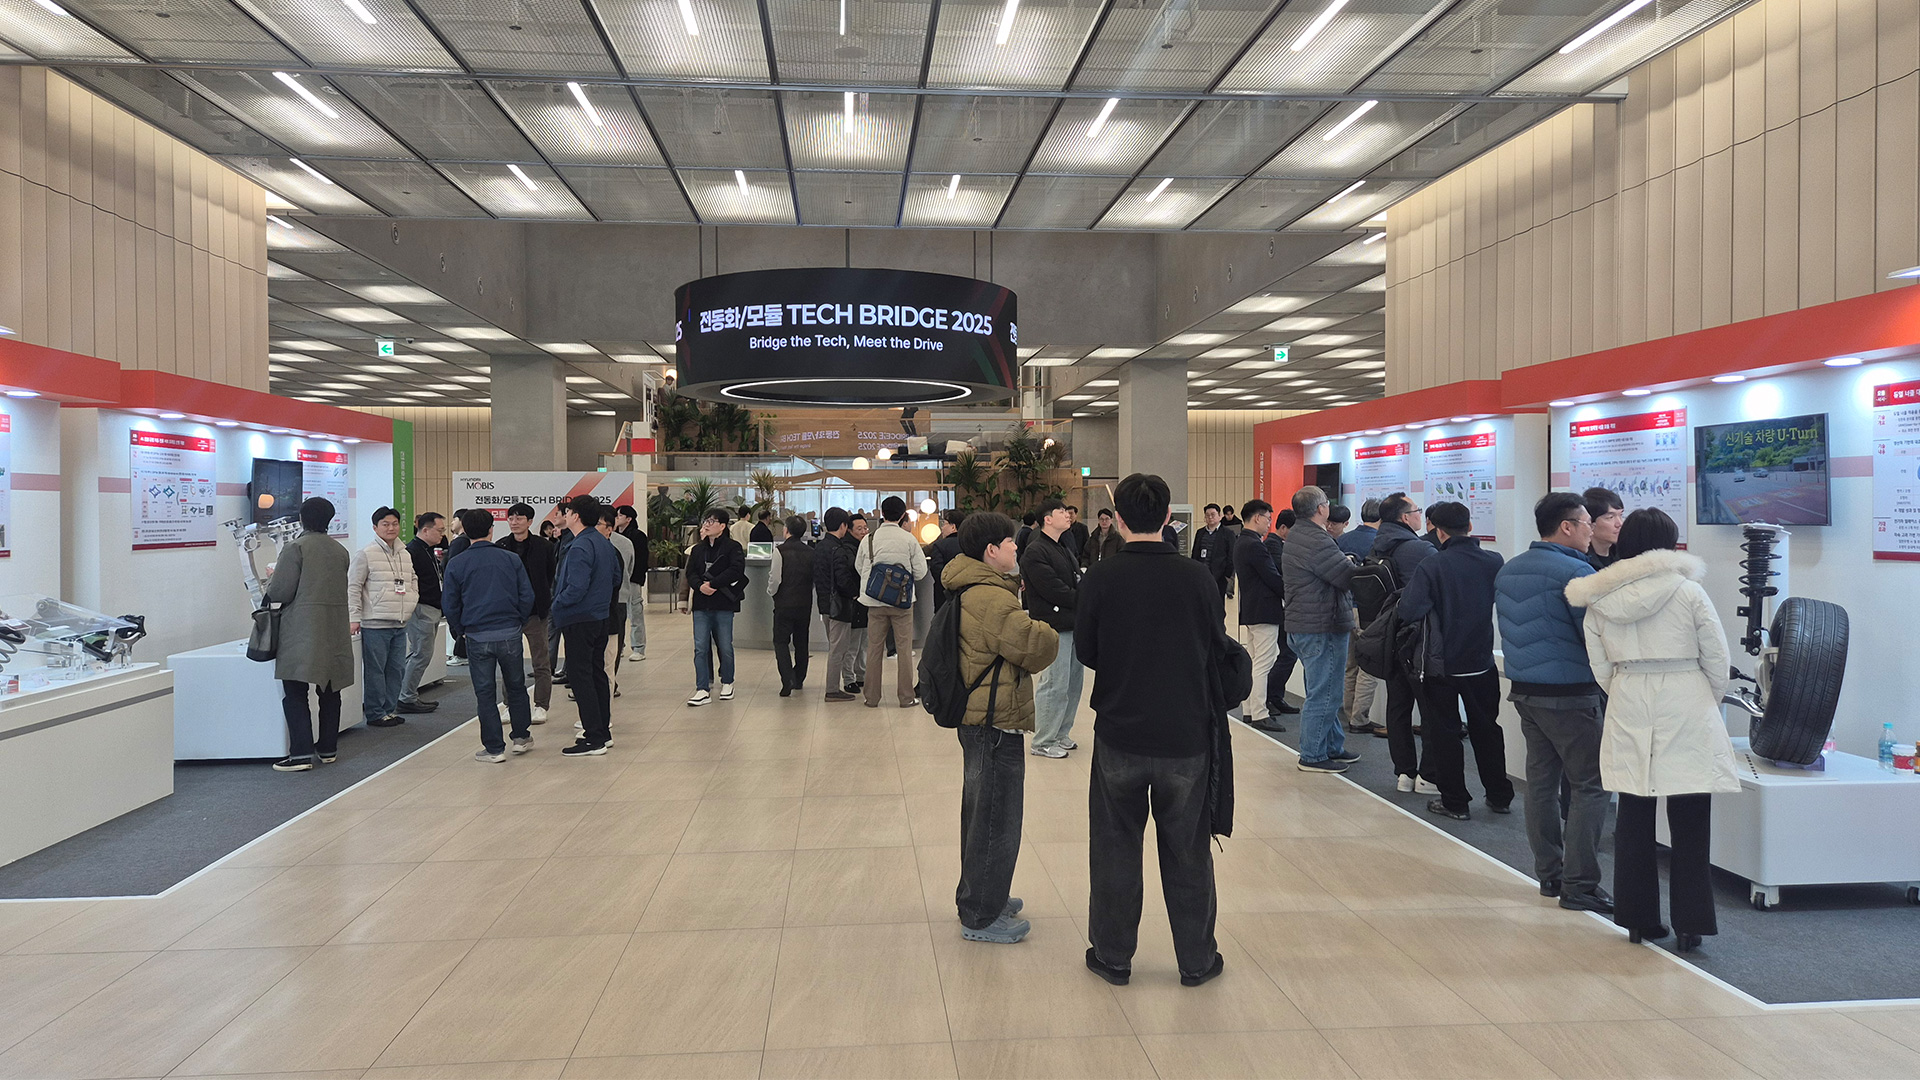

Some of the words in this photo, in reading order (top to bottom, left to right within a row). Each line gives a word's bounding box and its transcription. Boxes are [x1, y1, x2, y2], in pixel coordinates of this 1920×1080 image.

[699, 303, 783, 334] 전동화/모듈
[786, 303, 853, 327] TECH
[860, 303, 948, 330] BRIDGE
[951, 310, 993, 336] 2025
[749, 335, 787, 351] Bridge
[790, 334, 812, 348] the
[815, 334, 850, 350] Tech,
[853, 335, 887, 348] Meet
[890, 336, 911, 350] the
[914, 337, 943, 351] Drive
[1725, 431, 1754, 447] 신기술
[1755, 429, 1776, 444] 차량
[1777, 426, 1819, 442] U-Turn
[466, 481, 495, 490] MOBIS
[475, 495, 520, 505] 전동화/모듈
[522, 495, 547, 504] TECH
